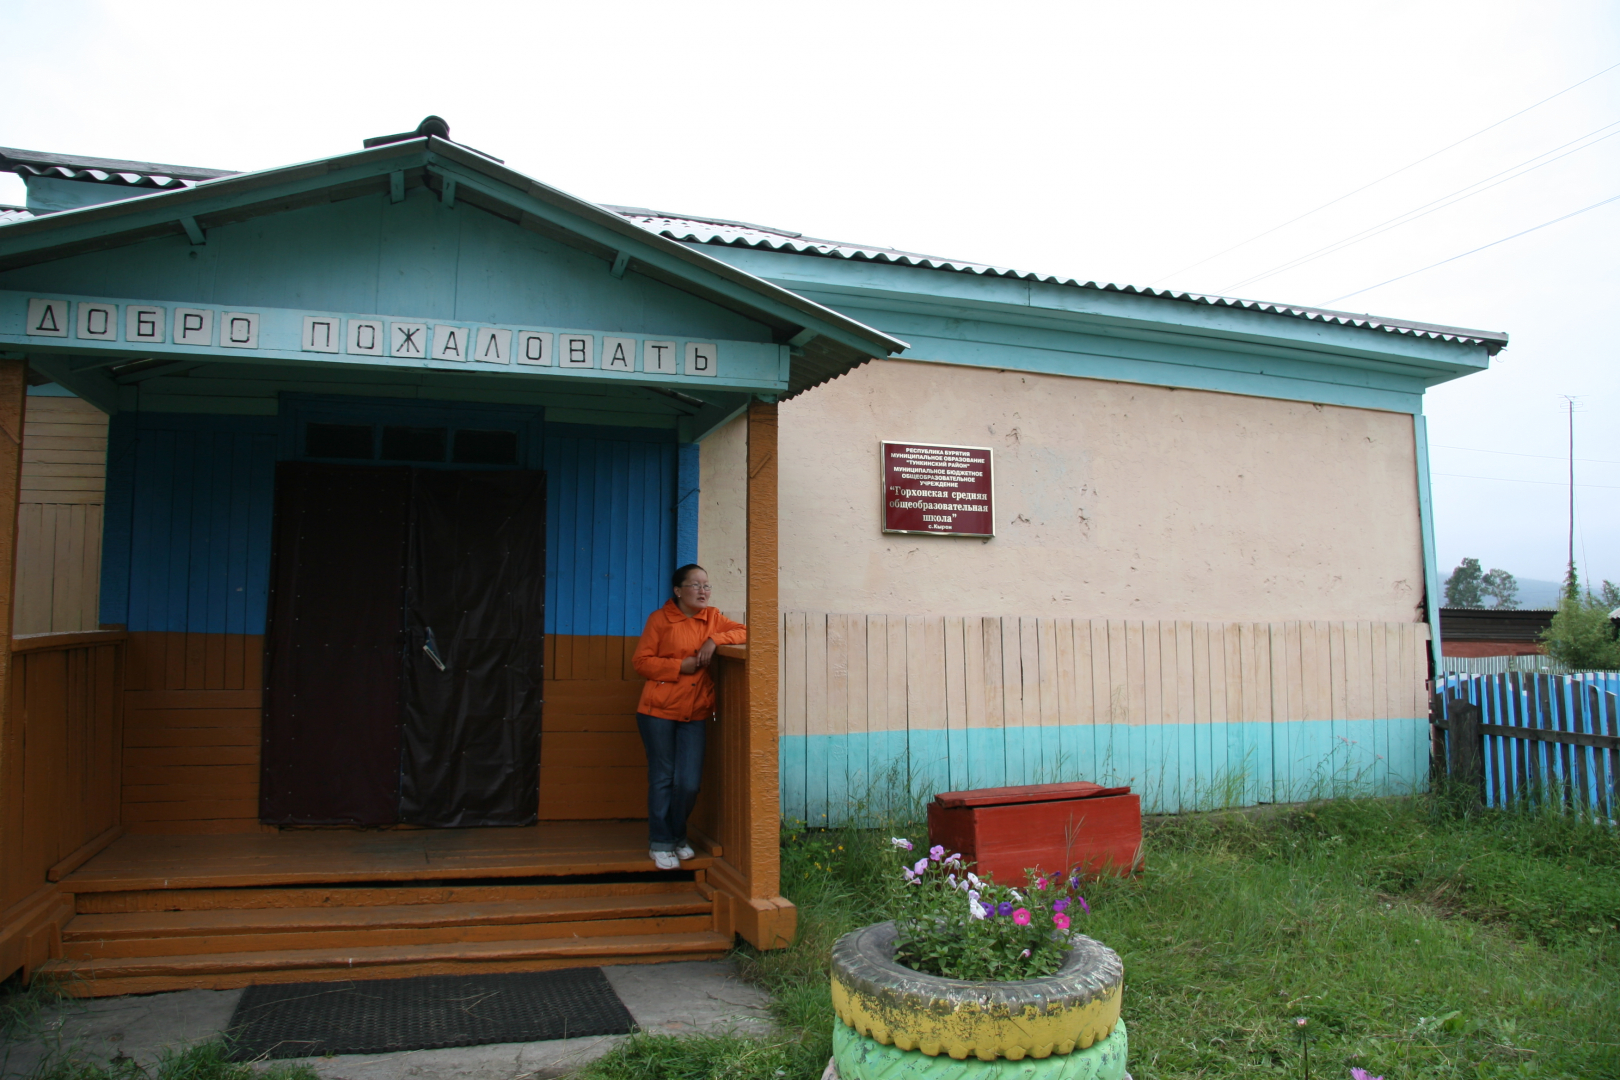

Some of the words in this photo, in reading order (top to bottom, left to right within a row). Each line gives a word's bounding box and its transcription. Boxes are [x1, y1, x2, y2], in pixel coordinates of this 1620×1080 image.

[36, 304, 251, 343] ДОБРО
[311, 321, 709, 371] ПОЖАЛОВАТЬ
[891, 453, 943, 461] МУНИЦИПАЛЬНОЕ
[944, 449, 970, 457] БУРЯТИЯ
[893, 466, 946, 475] МУНИЦИПАЛЬНОЕ
[946, 469, 983, 477] БЮДЖЕТНОЕ
[901, 473, 976, 482] ОБЩЕОБРАЗОВАТЕЛЬНОЕ
[920, 480, 959, 488] УЧРЕЖДЕНИЕ
[951, 491, 988, 501] средняя
[889, 499, 989, 512] общеобразовательная
